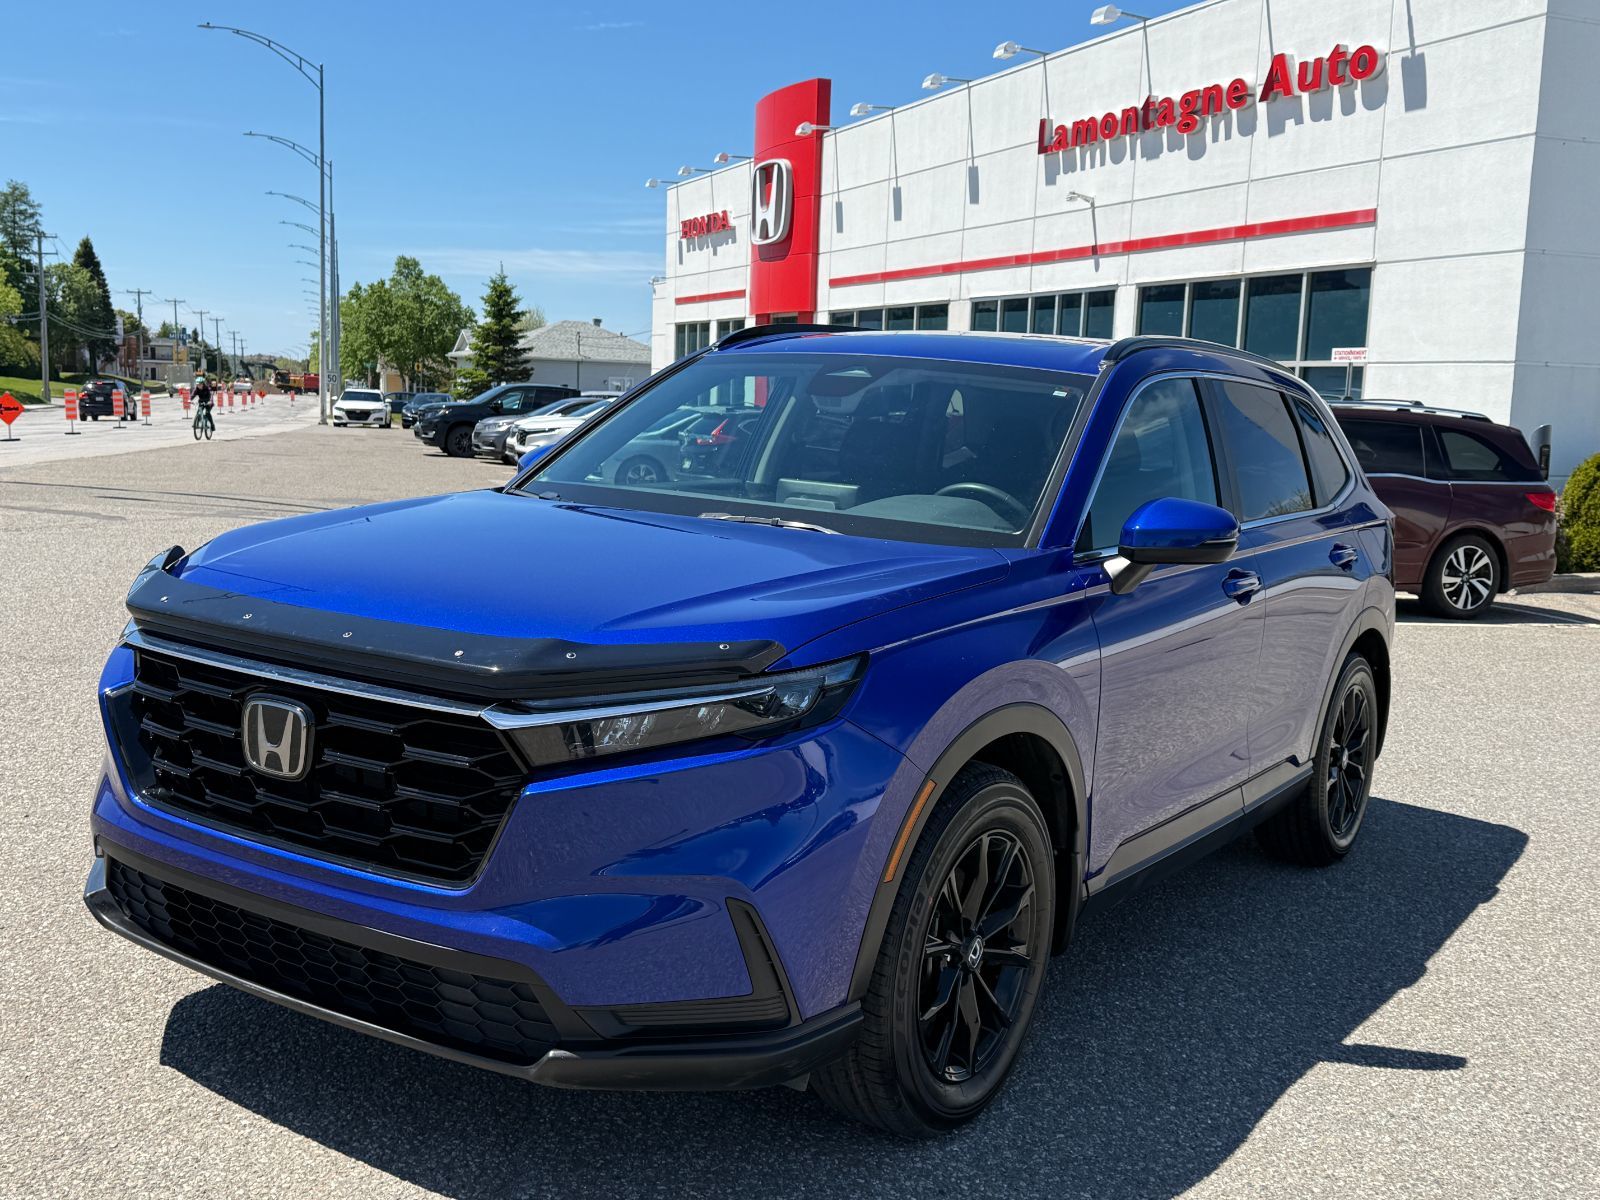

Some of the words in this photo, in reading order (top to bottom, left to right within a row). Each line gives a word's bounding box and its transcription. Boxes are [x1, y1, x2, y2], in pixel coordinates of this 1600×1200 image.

[1038, 78, 1249, 155] Lamontagne
[1258, 43, 1379, 103] Auto
[681, 210, 731, 239] HONDA
[327, 374, 337, 383] 50
